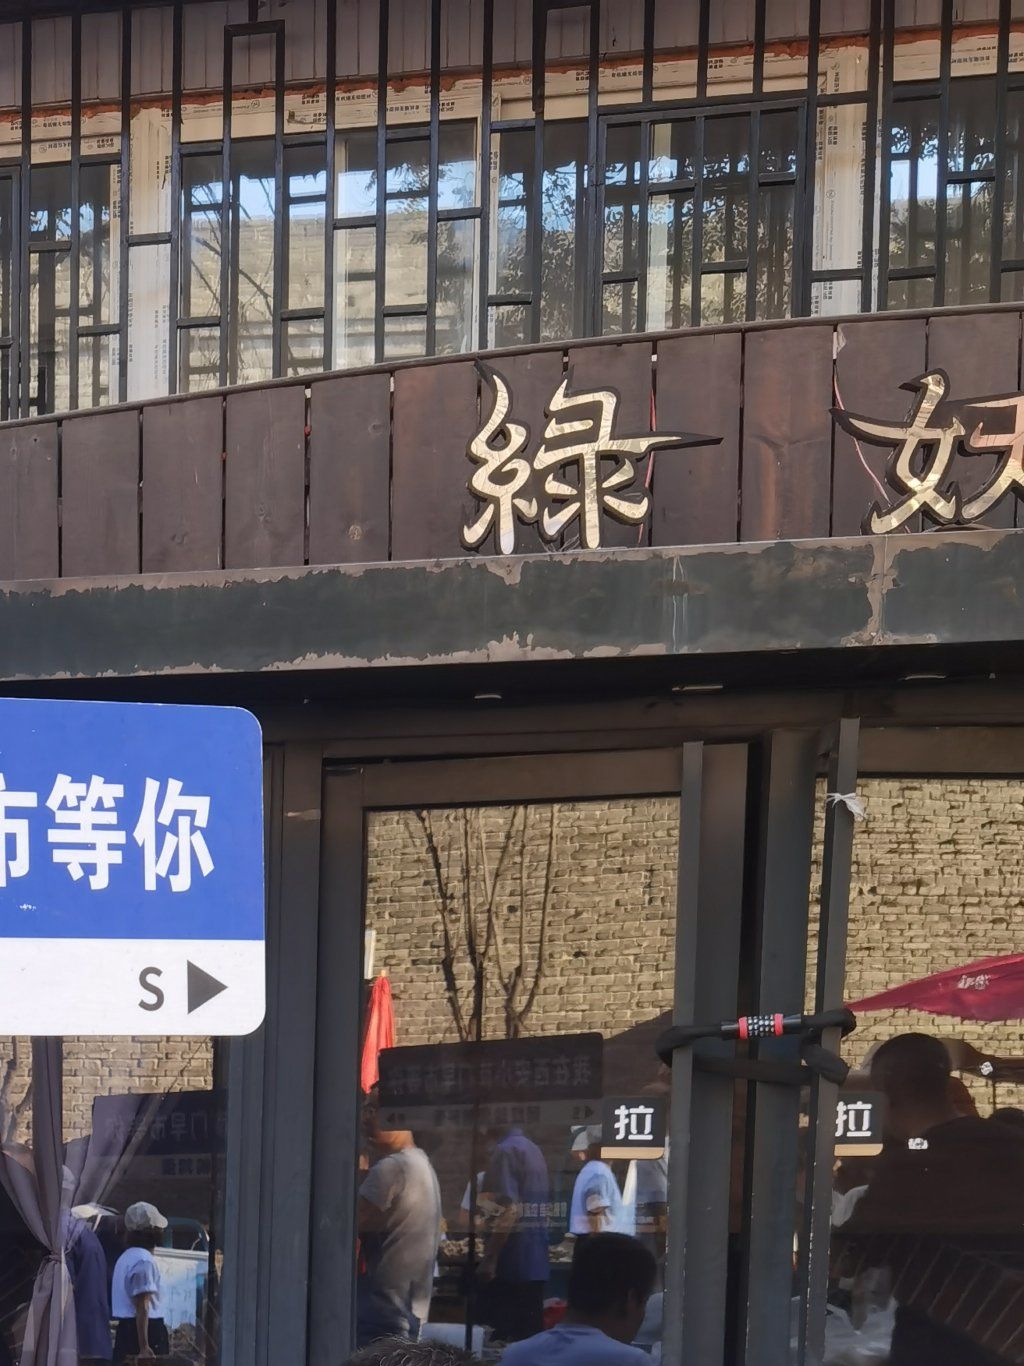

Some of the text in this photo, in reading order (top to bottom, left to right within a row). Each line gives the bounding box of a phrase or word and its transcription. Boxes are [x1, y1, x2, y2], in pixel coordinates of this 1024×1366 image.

[138, 966, 165, 1012] S
[614, 1105, 654, 1140] 拉
[834, 1101, 872, 1138] 拉
